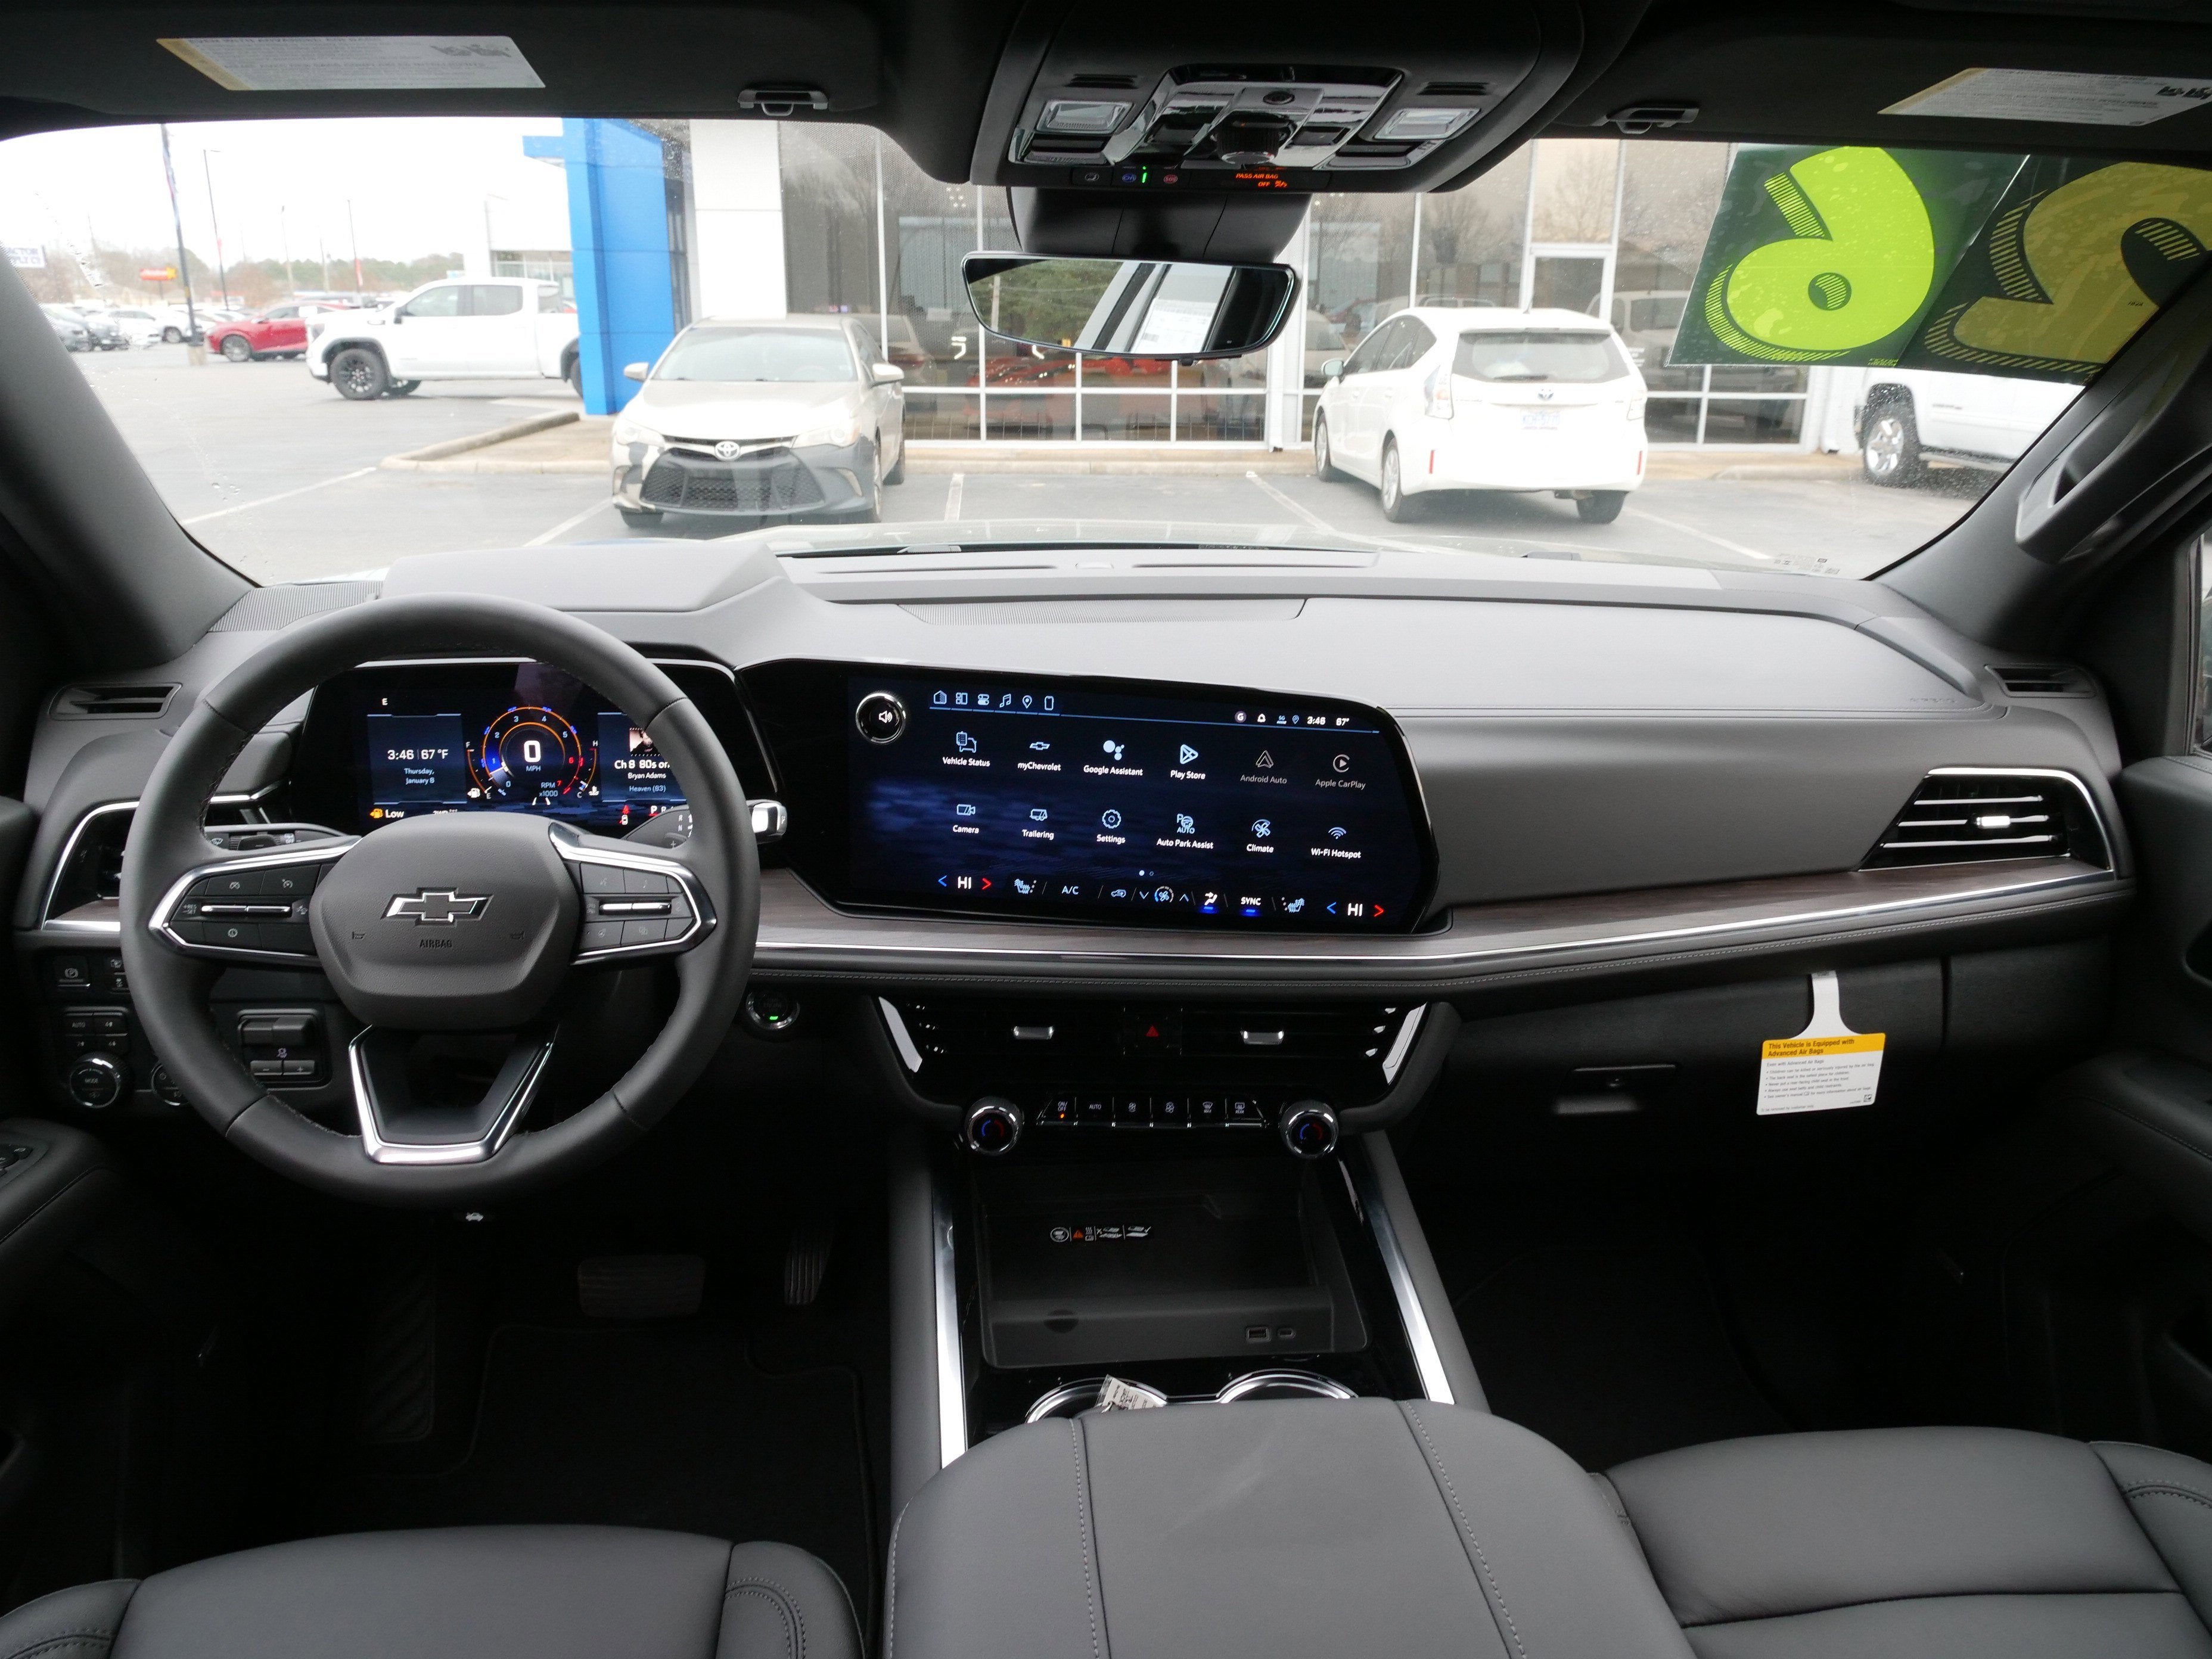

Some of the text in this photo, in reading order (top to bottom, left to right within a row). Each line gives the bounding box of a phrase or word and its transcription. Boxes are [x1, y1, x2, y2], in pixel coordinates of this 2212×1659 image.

[1307, 716, 1349, 726] 3:46 67°
[387, 749, 414, 760] 3:46
[421, 749, 435, 760] 67
[524, 740, 541, 763] 0
[614, 760, 627, 769] Ch
[628, 759, 635, 769] 8
[639, 759, 657, 769] 80s
[942, 757, 990, 767] Vehicle Status
[1018, 762, 1061, 771] myChevrolet
[1083, 765, 1143, 776] Google Assistant
[1170, 769, 1206, 780] Play Store
[627, 772, 645, 780] Bryan
[1240, 775, 1287, 784] Android Auto
[1315, 779, 1366, 790] Apple CarPlay
[385, 809, 404, 818] Low
[650, 805, 657, 814] P
[953, 825, 979, 834] Camera
[1022, 829, 1054, 840] Trailering
[1096, 834, 1126, 845] Settings
[1156, 838, 1214, 849] Auto Park Assist
[1246, 844, 1274, 853] Climate
[1310, 847, 1361, 859] Wi-Fi Hotspot
[957, 876, 971, 889] HI
[1061, 885, 1079, 895] A/C
[1241, 896, 1262, 906] SYNC
[1347, 902, 1363, 917] HI
[420, 939, 452, 948] AIRBAG
